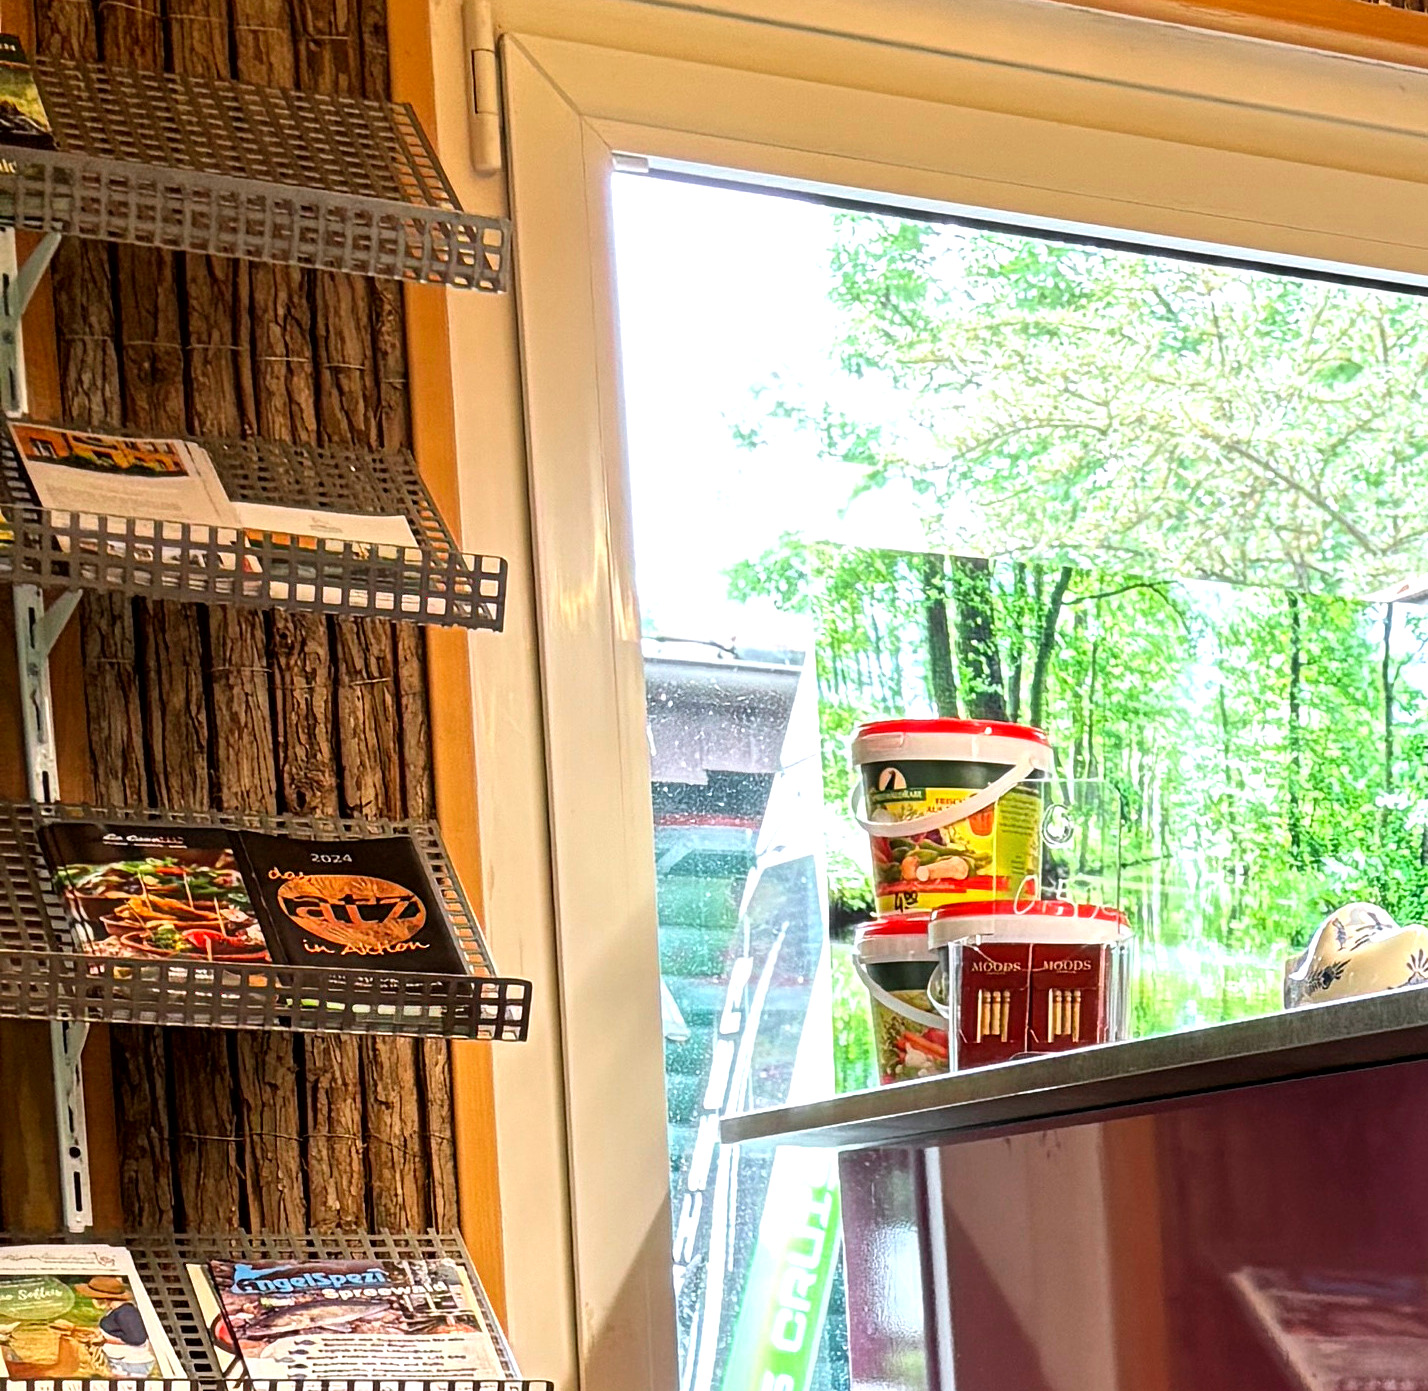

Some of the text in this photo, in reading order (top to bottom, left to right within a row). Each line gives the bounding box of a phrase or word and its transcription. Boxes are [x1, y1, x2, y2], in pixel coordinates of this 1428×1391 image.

[310, 853, 353, 863] 2024
[303, 939, 335, 954] in
[971, 961, 1022, 973] MOODS
[1043, 959, 1092, 971] MOODS
[321, 1280, 448, 1301] Spreewald
